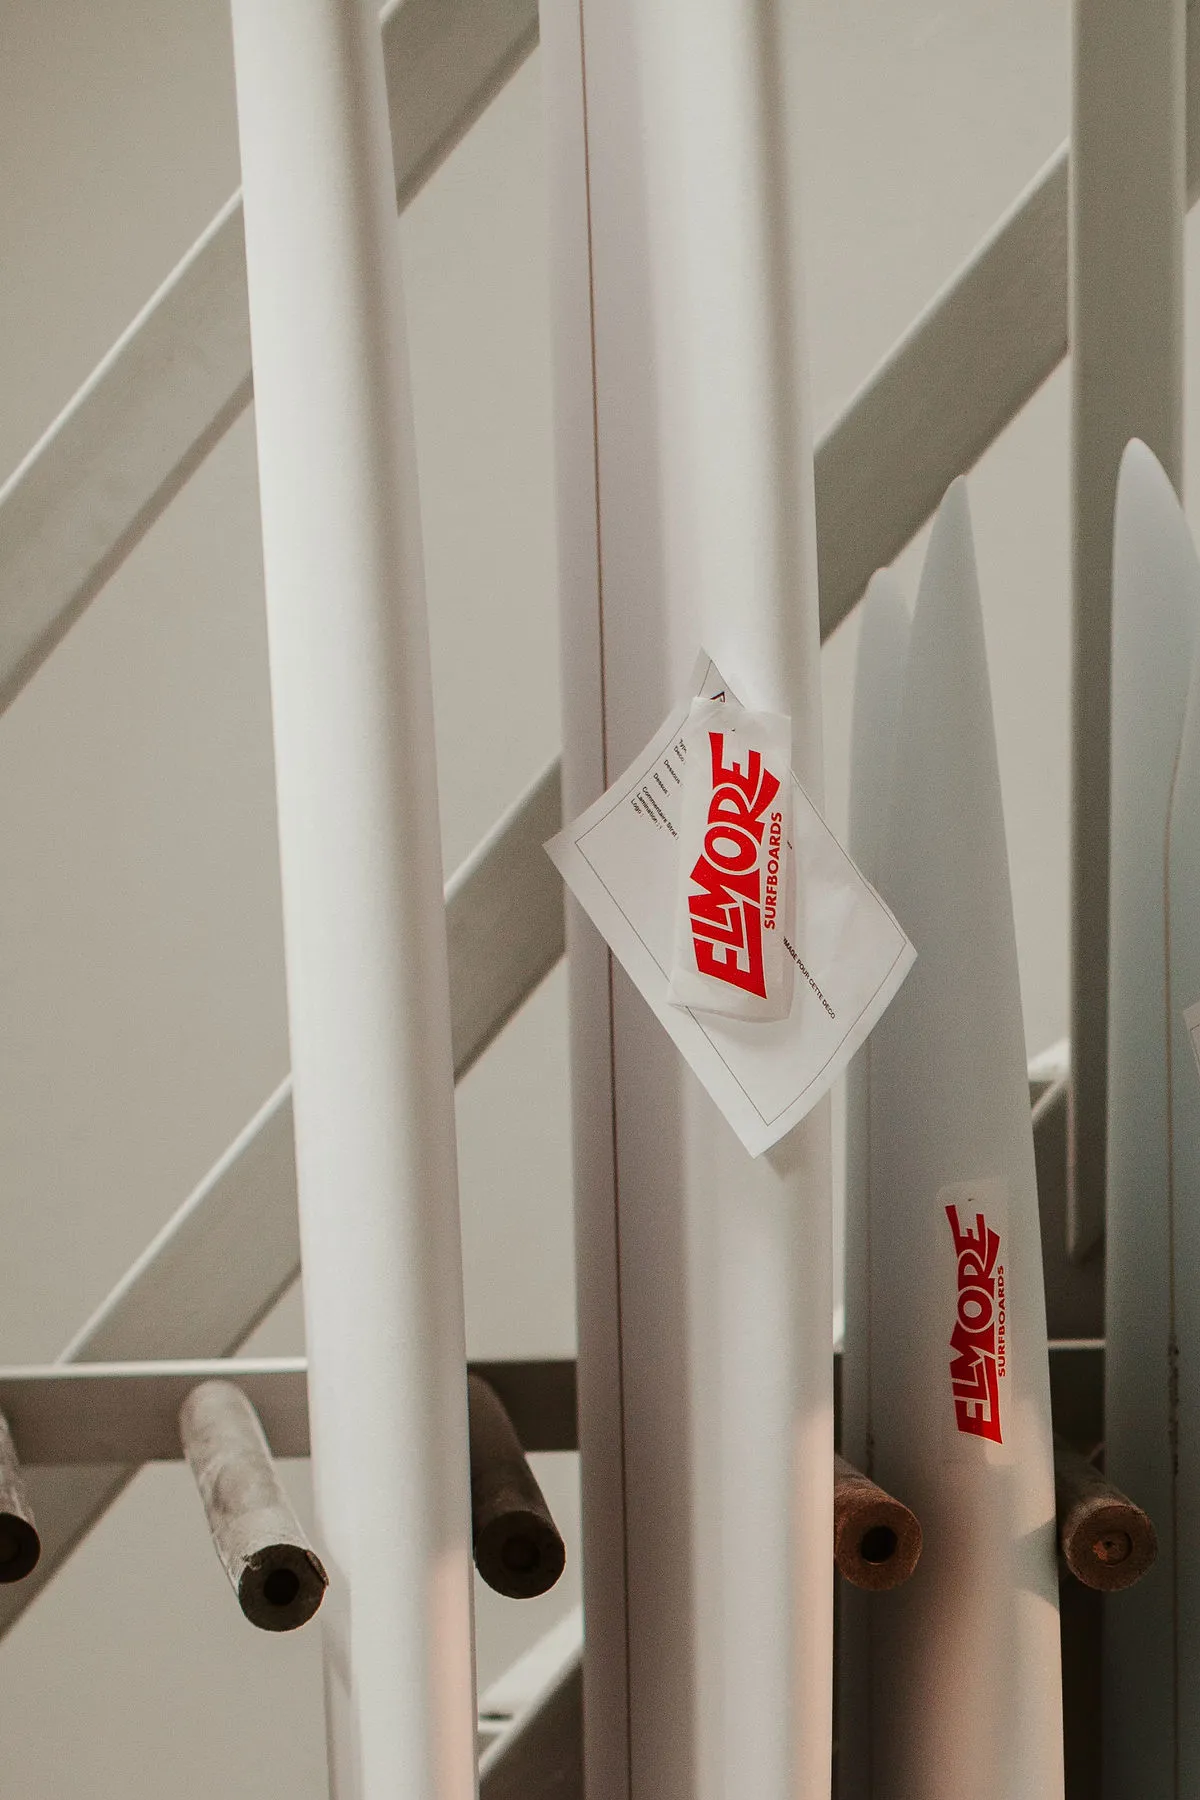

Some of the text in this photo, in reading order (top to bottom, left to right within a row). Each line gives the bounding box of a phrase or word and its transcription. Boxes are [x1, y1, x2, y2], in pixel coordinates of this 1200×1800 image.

[688, 732, 781, 999] ELMORE
[764, 812, 783, 930] SURFBOARDS
[796, 959, 810, 979] POUR
[808, 978, 823, 1001] CETTE
[822, 999, 835, 1019] DECO
[944, 1204, 1003, 1445] ELMORE
[996, 1265, 1006, 1377] SURFBOARDS
